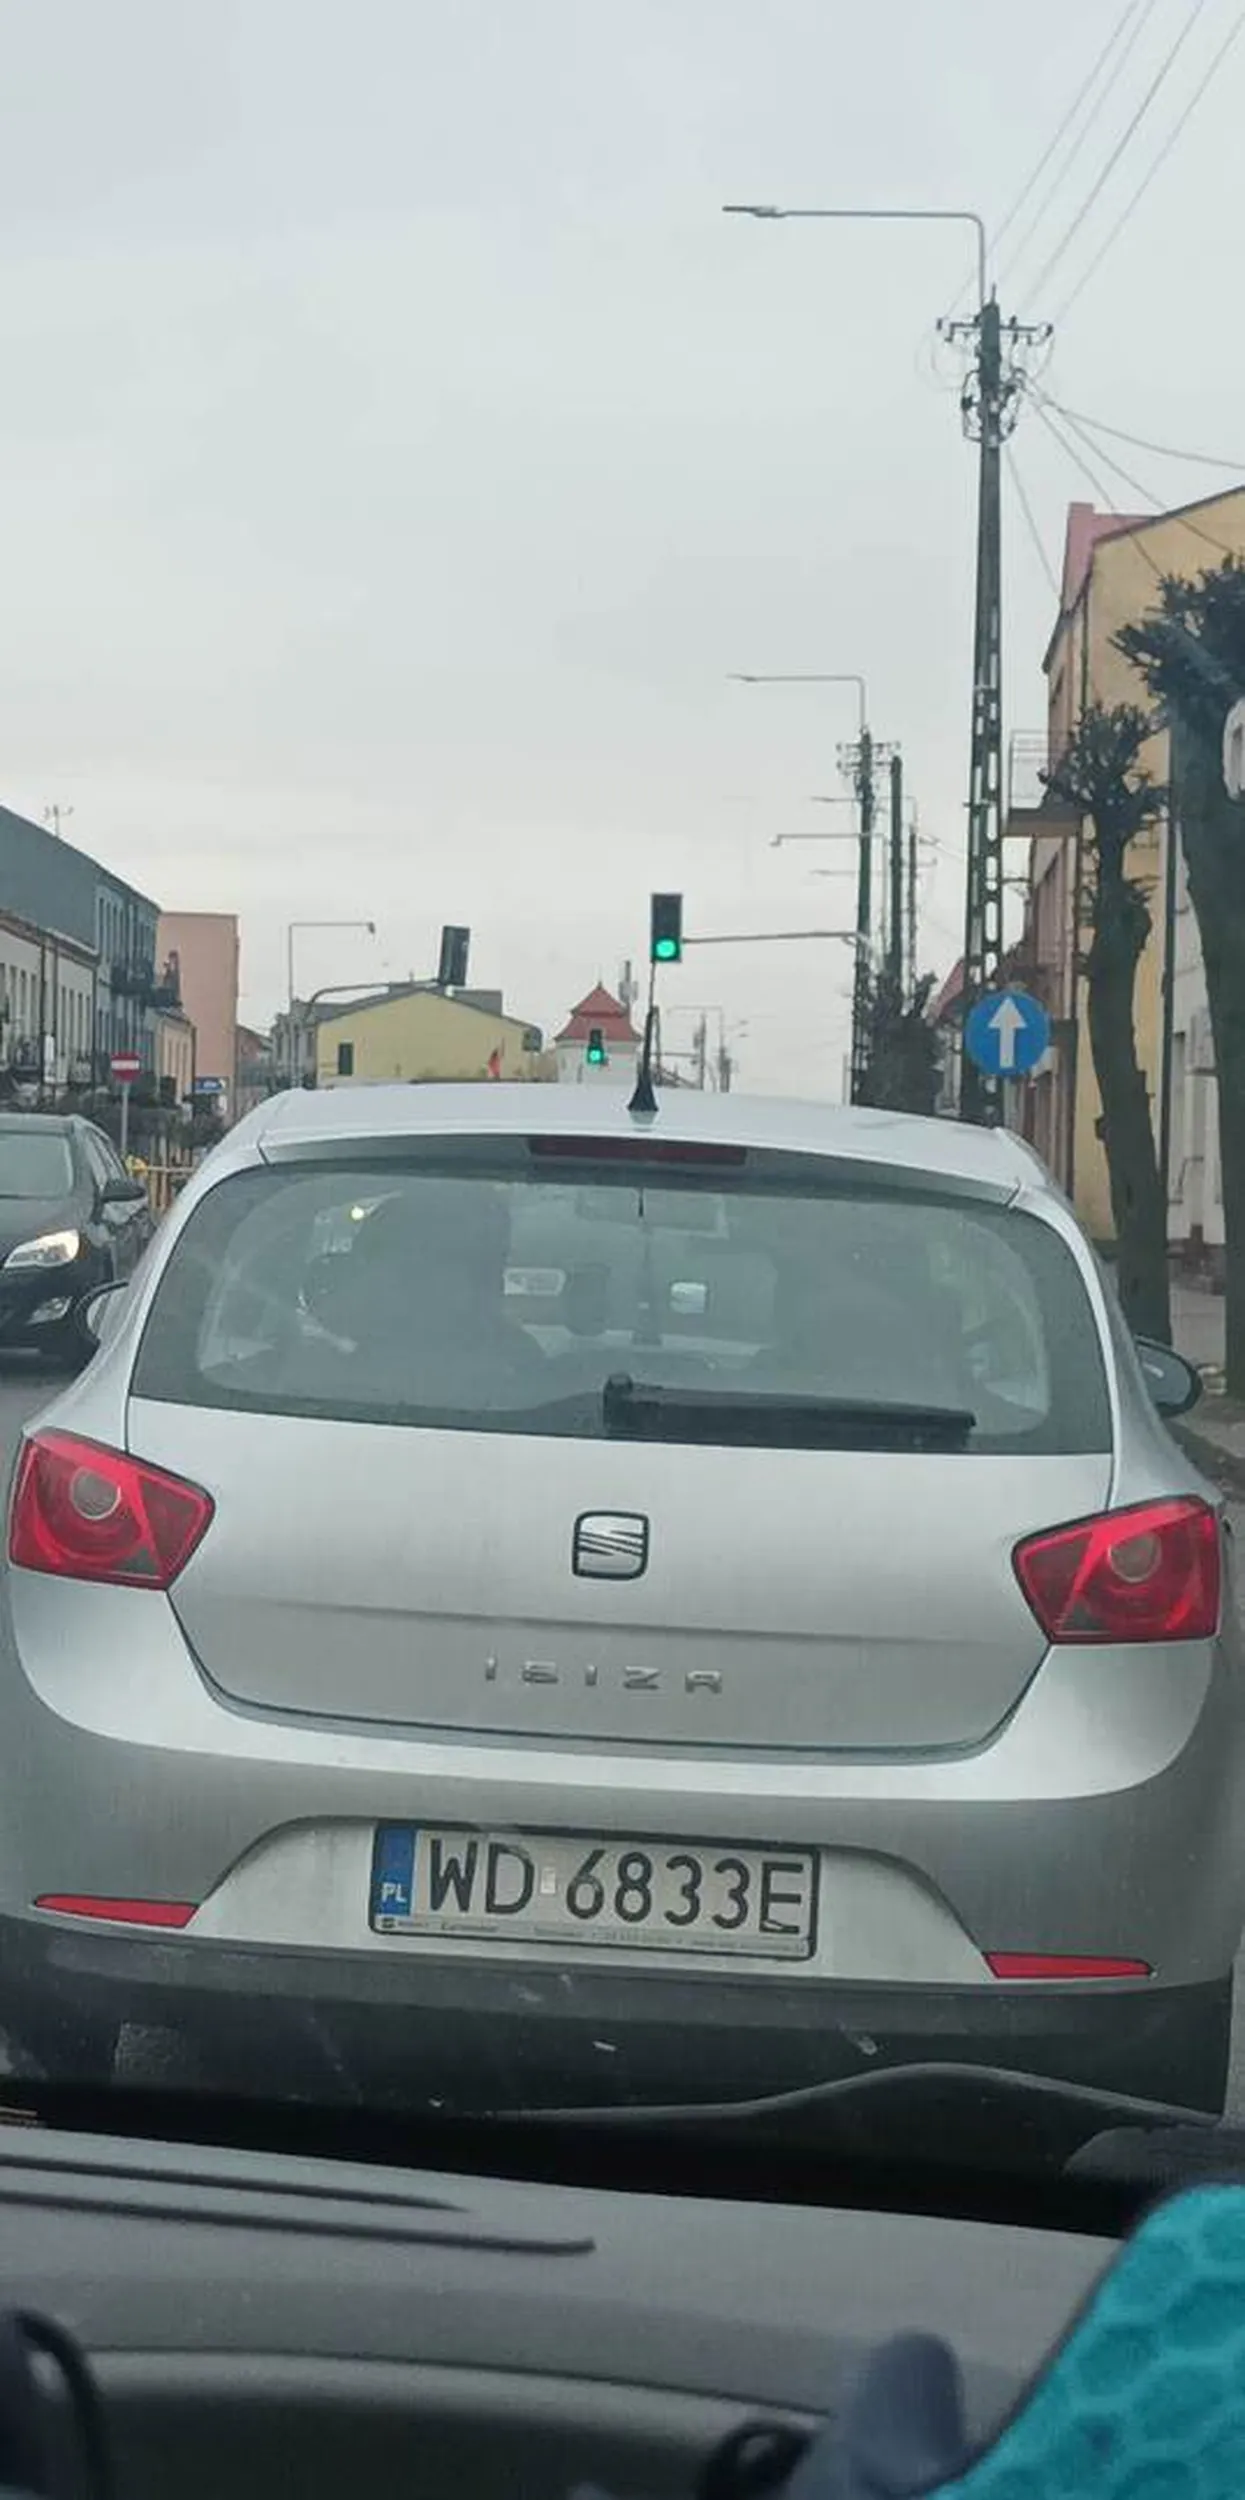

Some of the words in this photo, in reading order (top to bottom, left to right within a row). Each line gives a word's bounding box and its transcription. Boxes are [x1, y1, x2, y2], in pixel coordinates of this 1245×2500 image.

[485, 1656, 723, 1694] IBIZA
[381, 1882, 407, 1903] PL
[429, 1838, 535, 1915] WD
[565, 1849, 804, 1934] 6833E
